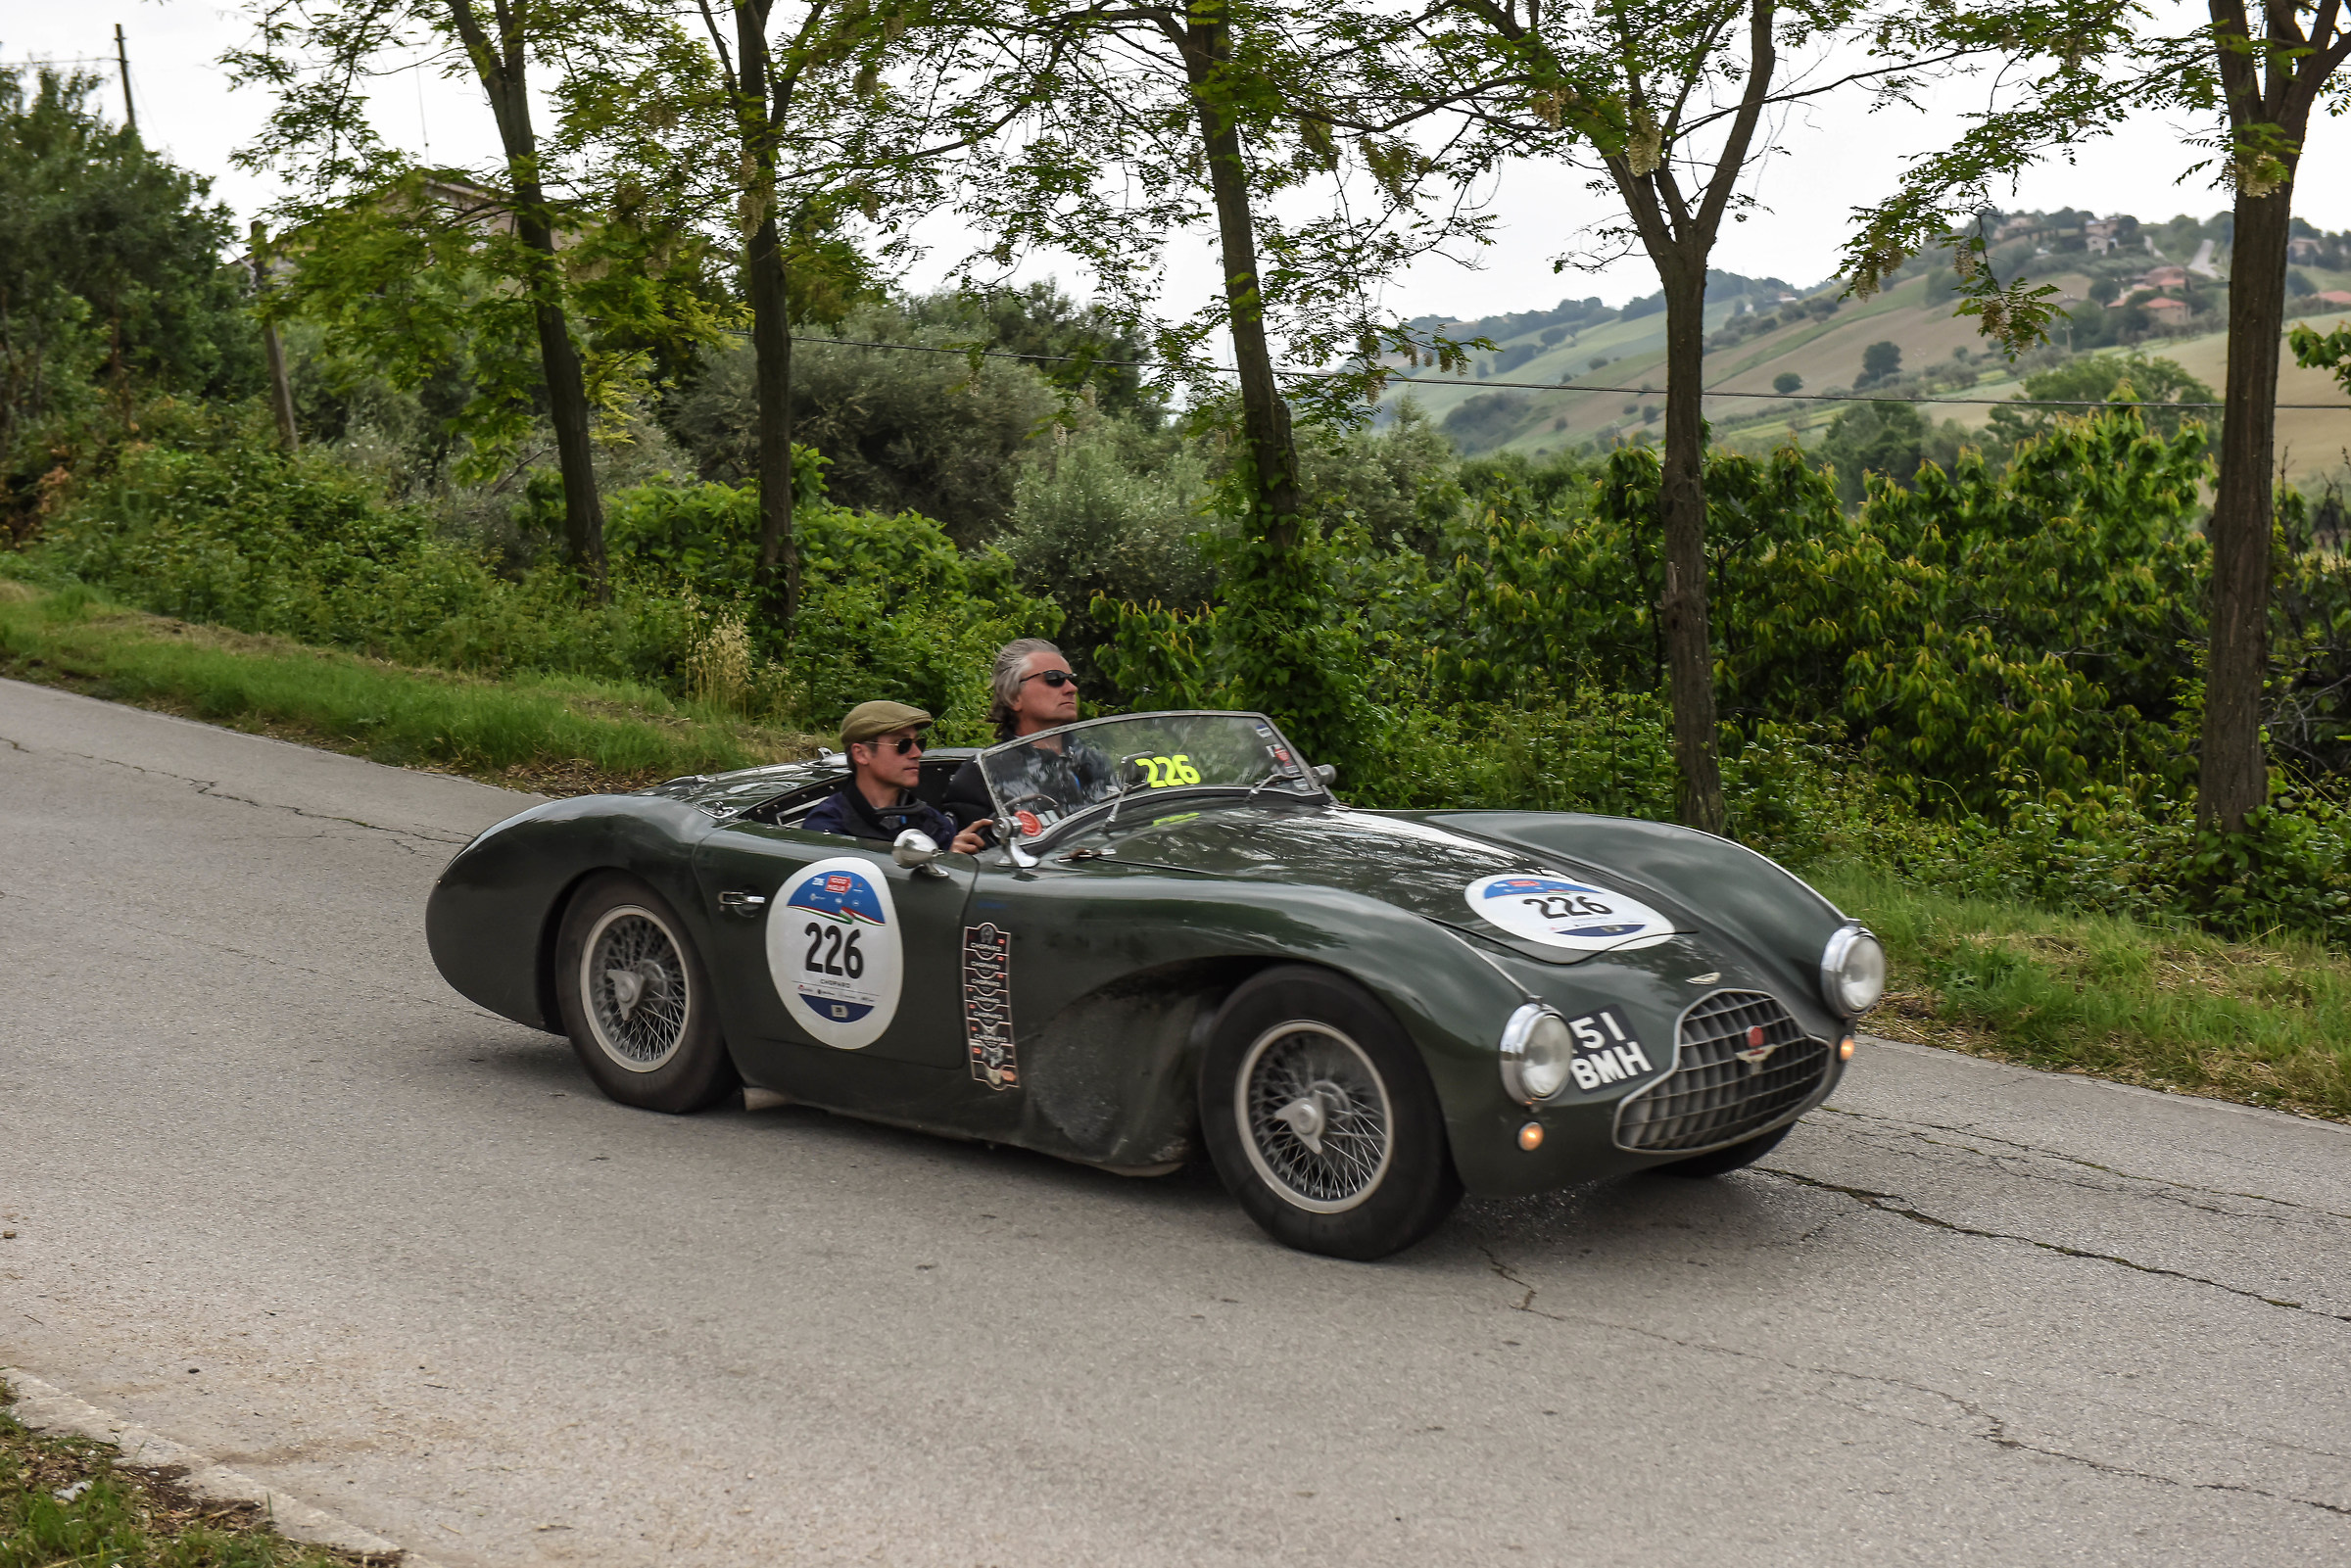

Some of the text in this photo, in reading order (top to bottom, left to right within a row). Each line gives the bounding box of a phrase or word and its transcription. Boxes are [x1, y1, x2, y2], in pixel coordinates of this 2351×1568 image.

[1134, 754, 1201, 787] 226
[1522, 895, 1612, 919] 226
[805, 922, 863, 979] 226
[1569, 1041, 1653, 1090] BMH
